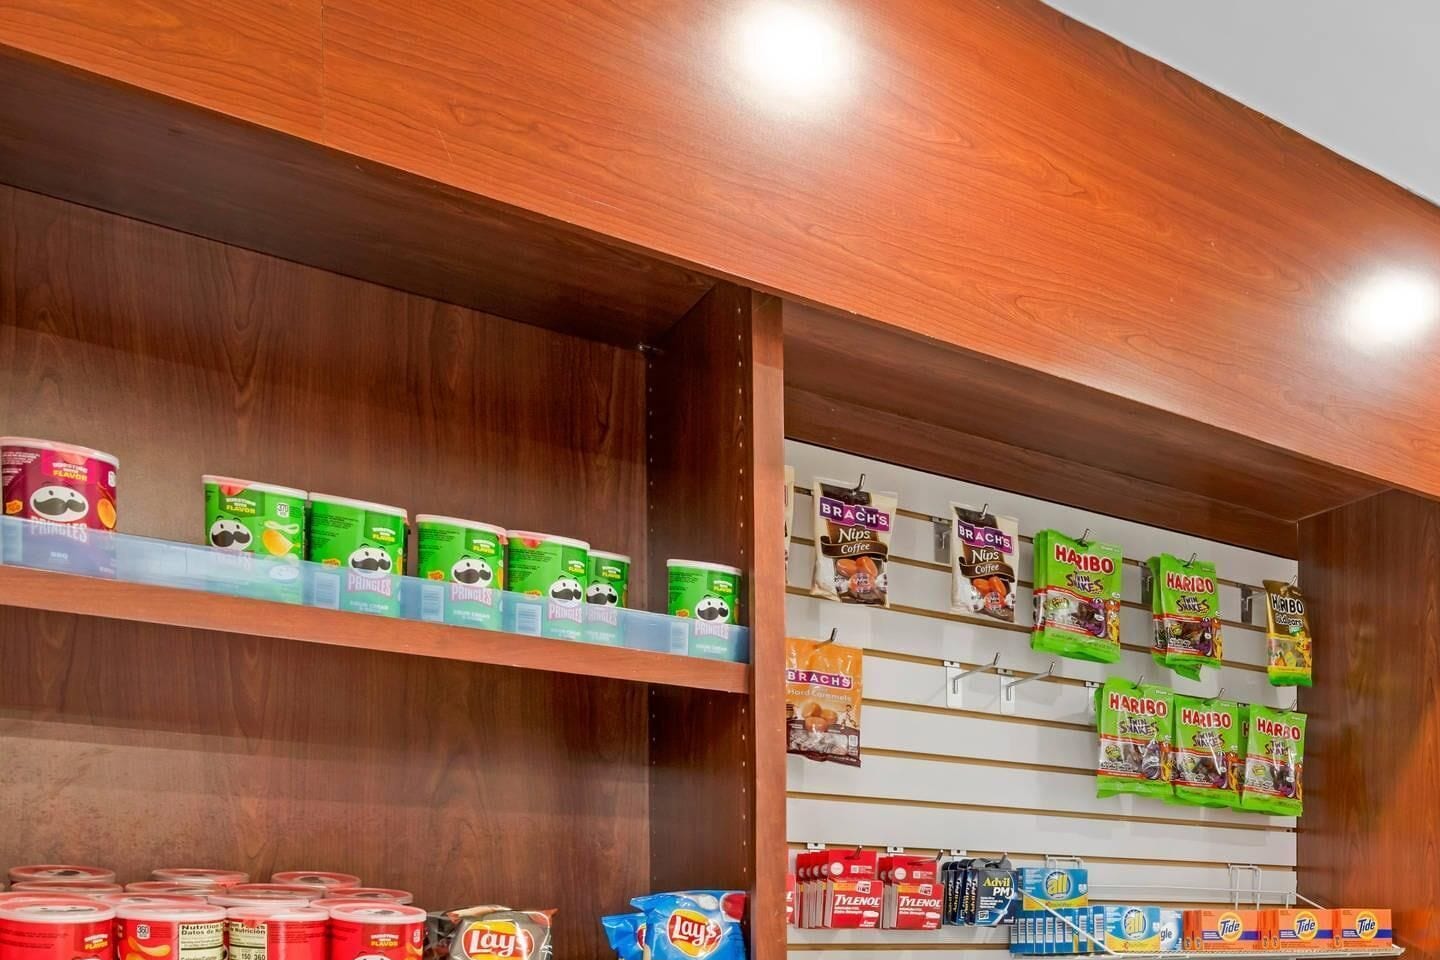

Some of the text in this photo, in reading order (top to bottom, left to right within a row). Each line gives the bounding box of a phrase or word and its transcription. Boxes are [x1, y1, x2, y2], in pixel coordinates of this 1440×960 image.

[53, 469, 88, 482] FLAVOR
[226, 505, 256, 515] FLAVOR
[821, 502, 888, 526] BRACH'S
[31, 516, 88, 543] PRINGLES
[838, 528, 871, 543] Nips
[959, 525, 1012, 549] BRACH'S
[841, 543, 871, 555] Coffee
[972, 549, 999, 564] Nips
[975, 563, 1000, 575] Coffee
[1055, 545, 1114, 574] HARIBO
[348, 573, 393, 597] PRINGLES
[1167, 572, 1214, 593] HARIBO
[452, 583, 493, 607] PRINGLES
[549, 601, 582, 623] PRINGLES
[695, 619, 729, 641] PRINGLES
[1109, 692, 1167, 717] HARIBO
[1182, 709, 1231, 729] HARIBO
[1257, 717, 1300, 740] HARBO
[983, 877, 1010, 887] Advil
[993, 887, 1010, 896] PM
[1047, 873, 1068, 896] all
[834, 893, 881, 906] TYLENOL
[899, 895, 941, 908] TYLENOL
[1126, 911, 1145, 935] all
[1220, 920, 1240, 933] Tide
[1296, 918, 1315, 932] Tide
[1358, 918, 1376, 932] Tide
